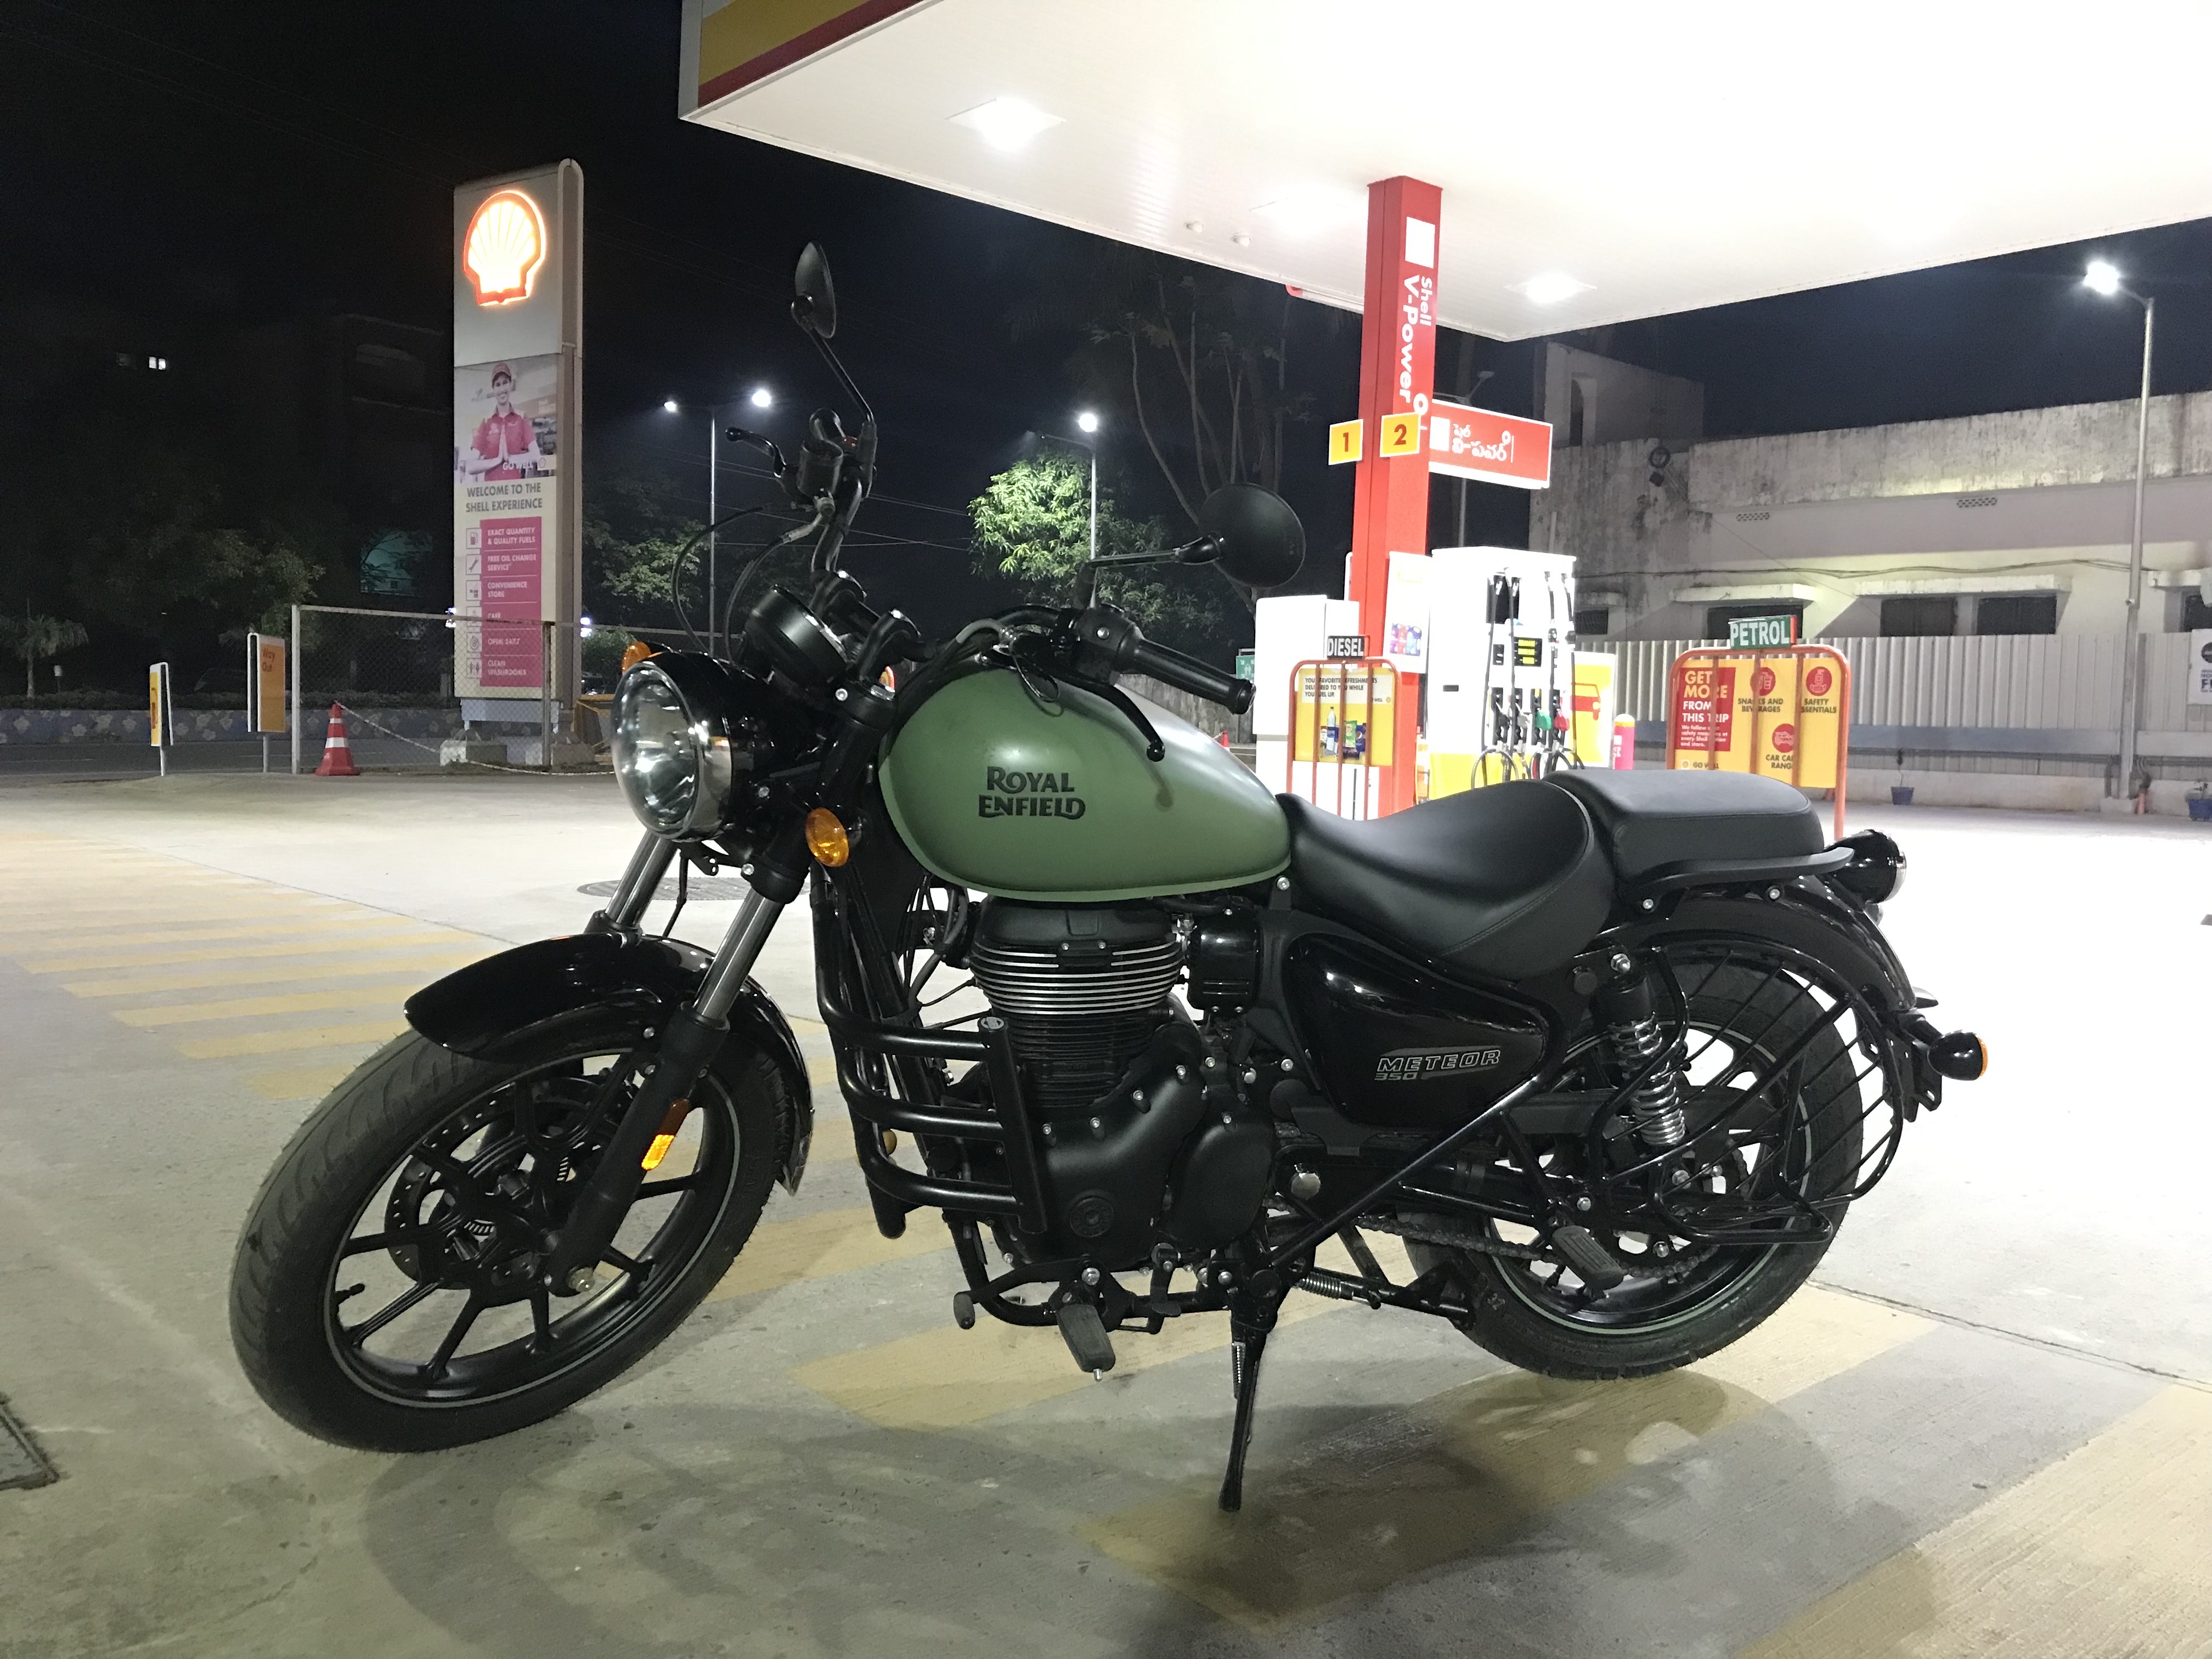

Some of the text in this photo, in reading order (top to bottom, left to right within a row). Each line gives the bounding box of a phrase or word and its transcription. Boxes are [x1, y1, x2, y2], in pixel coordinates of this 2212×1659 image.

[1420, 275, 1432, 326] Shell
[1400, 274, 1420, 403] V-Power
[1343, 432, 1349, 452] 1
[1393, 424, 1407, 445] 2
[467, 483, 541, 497] WELCOME TO THE
[466, 498, 542, 512] SHELL EXPERIENCE
[1730, 620, 1790, 647] PETROL
[262, 648, 275, 663] Way
[1327, 637, 1364, 656] DIESEL
[1685, 670, 1713, 684] GET
[1683, 701, 1712, 710] FROM
[1683, 713, 1705, 723] THIS
[988, 766, 1075, 794] ROYAL
[979, 794, 1086, 820] ENFIELD
[1377, 1049, 1501, 1072] METEOR
[1374, 1072, 1418, 1080] 350
